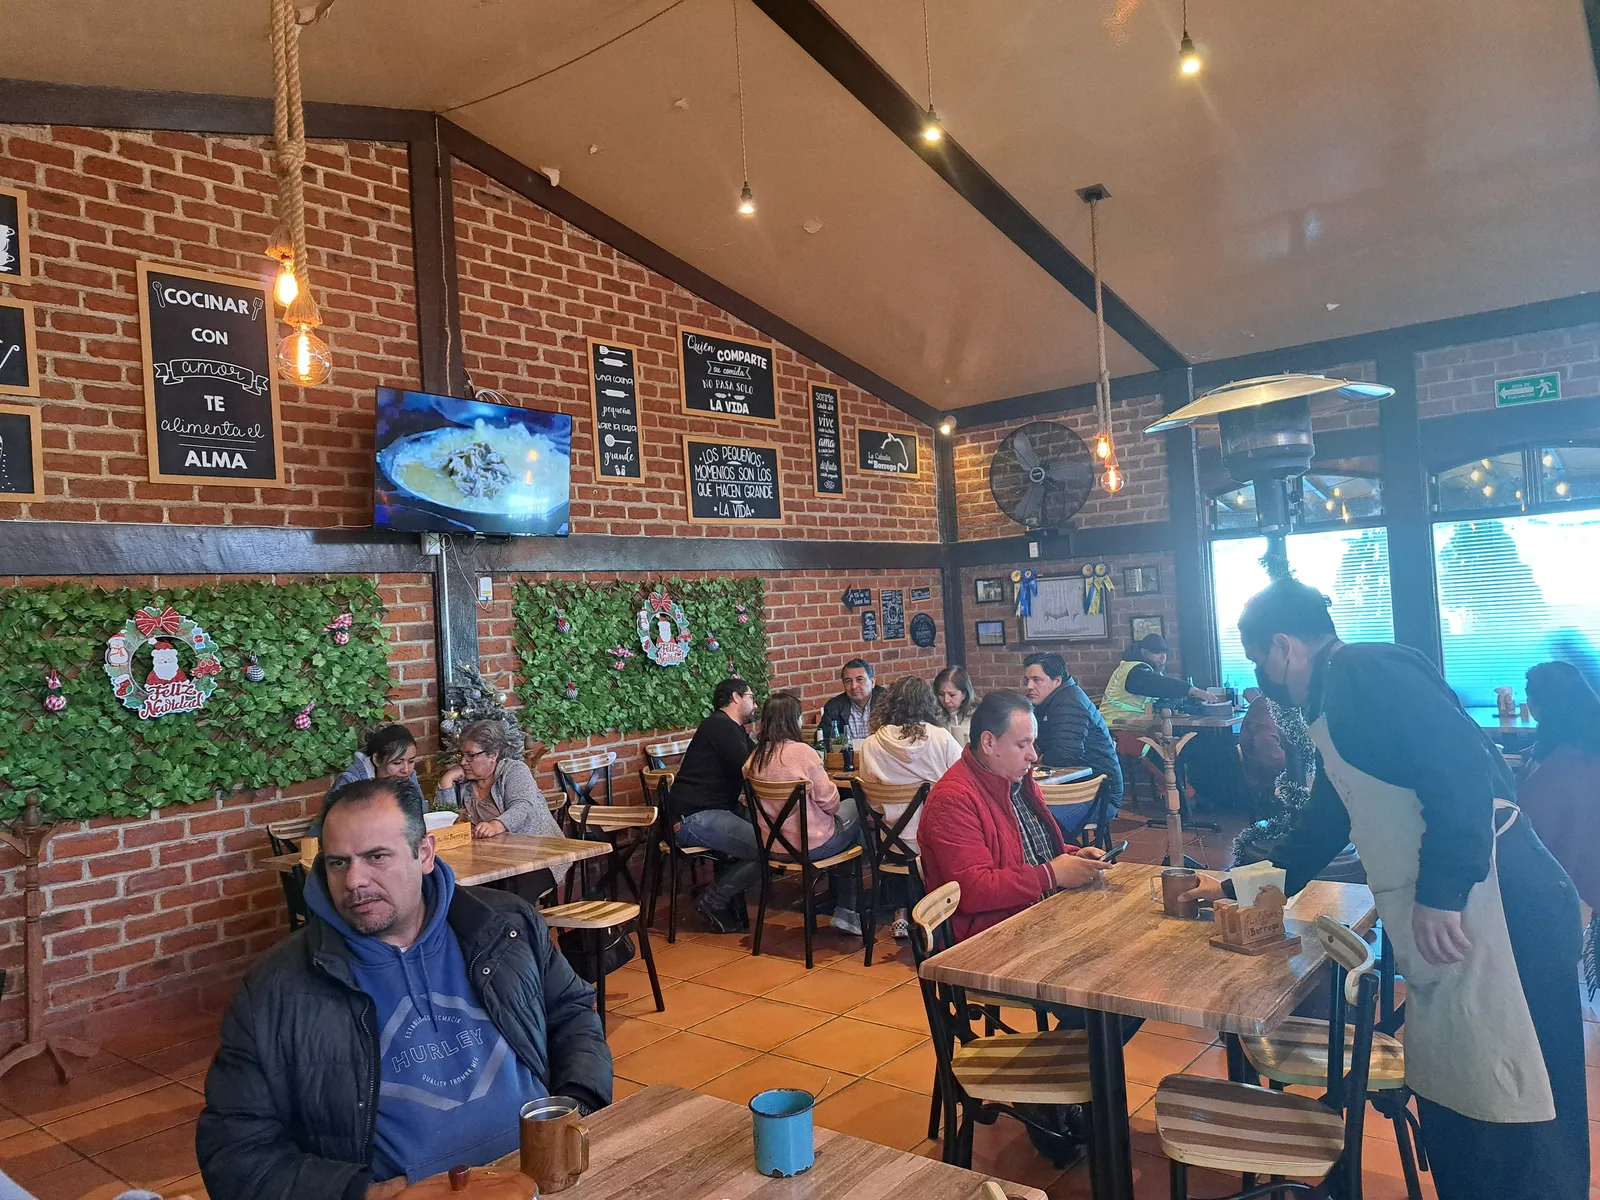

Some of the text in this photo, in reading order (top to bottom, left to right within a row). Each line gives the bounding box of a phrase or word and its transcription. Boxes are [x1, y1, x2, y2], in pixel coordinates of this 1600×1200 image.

[163, 288, 250, 316] COCINAR
[191, 327, 229, 346] CON
[684, 333, 716, 355] Quien
[716, 349, 768, 370] COMPARTE
[181, 359, 246, 381] amor
[723, 366, 745, 376] comida
[702, 379, 754, 395] NO PASA SOLO
[203, 394, 226, 413] TE
[709, 398, 750, 415] LA VIDA
[160, 417, 265, 439] alimenta el
[818, 414, 834, 428] vive
[818, 437, 836, 448] ama
[184, 449, 248, 470] ALMA
[604, 447, 635, 466] grande
[701, 446, 762, 467] LOS PEQUEÑOS
[694, 464, 772, 482] MOMENTOS SON LOS
[873, 460, 897, 472] Borrego
[697, 482, 774, 499] QUE HACEN GRANDE
[719, 501, 752, 518] LA VIDA
[150, 683, 197, 701] Feliz
[140, 691, 204, 718] Navidad
[1250, 923, 1280, 936] Borrego
[391, 1027, 484, 1074] HURLEY
[421, 1073, 447, 1087] QUALITY
